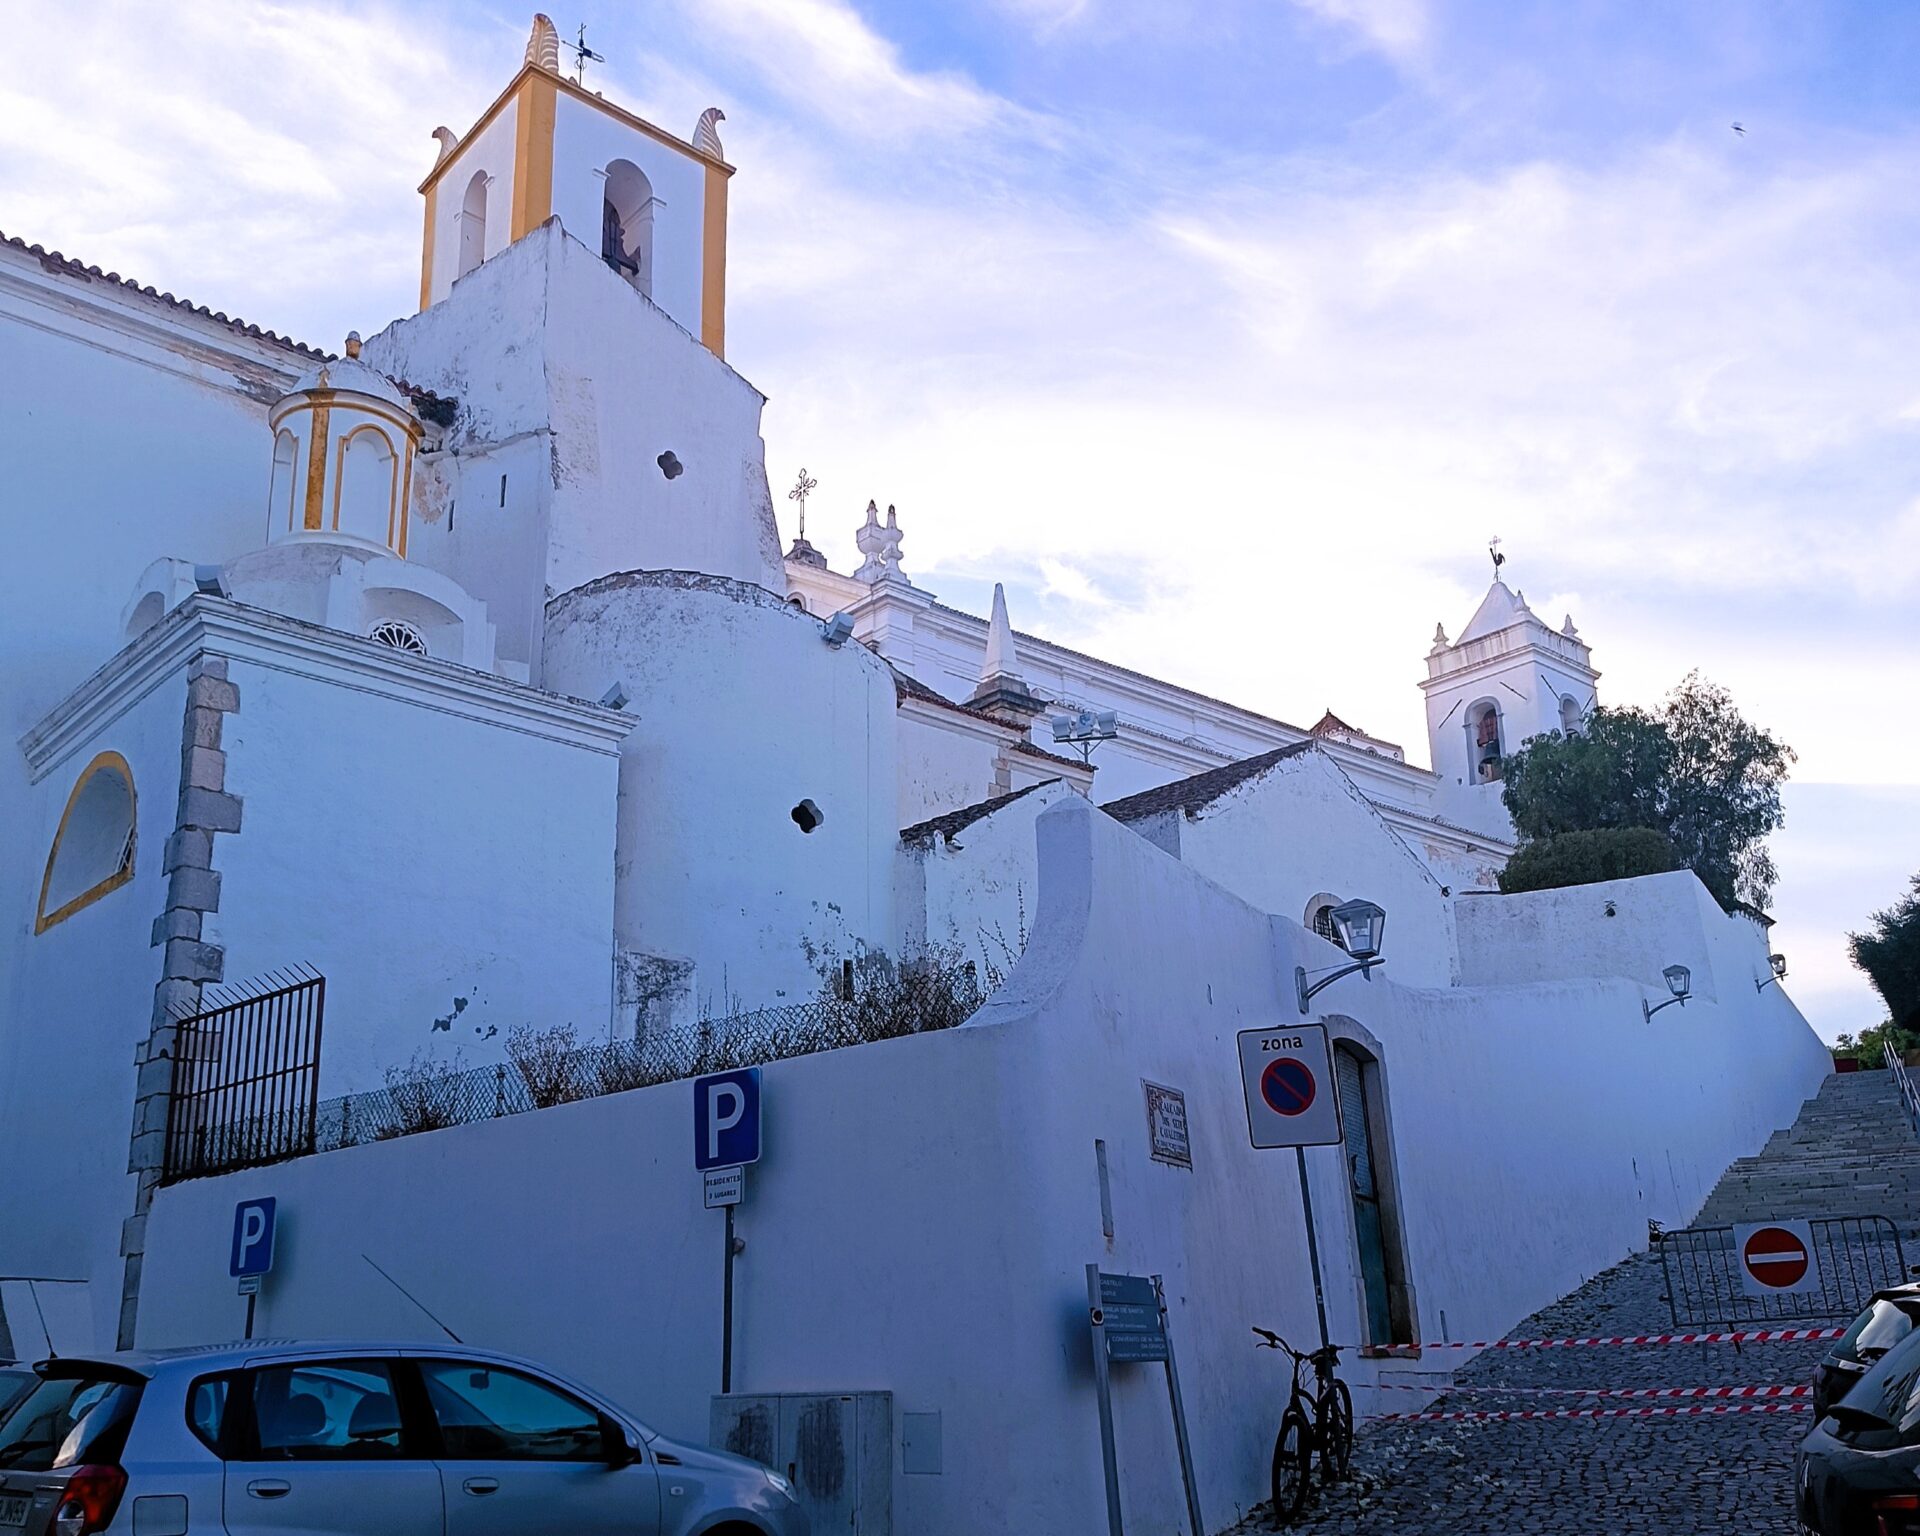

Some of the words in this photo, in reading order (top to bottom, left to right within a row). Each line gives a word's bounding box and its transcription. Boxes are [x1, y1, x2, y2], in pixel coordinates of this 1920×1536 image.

[1261, 1036, 1304, 1051] zona
[708, 1081, 745, 1159] P
[706, 1174, 741, 1187] RESIDENTES
[714, 1189, 737, 1199] LUGARES
[238, 1205, 266, 1269] P
